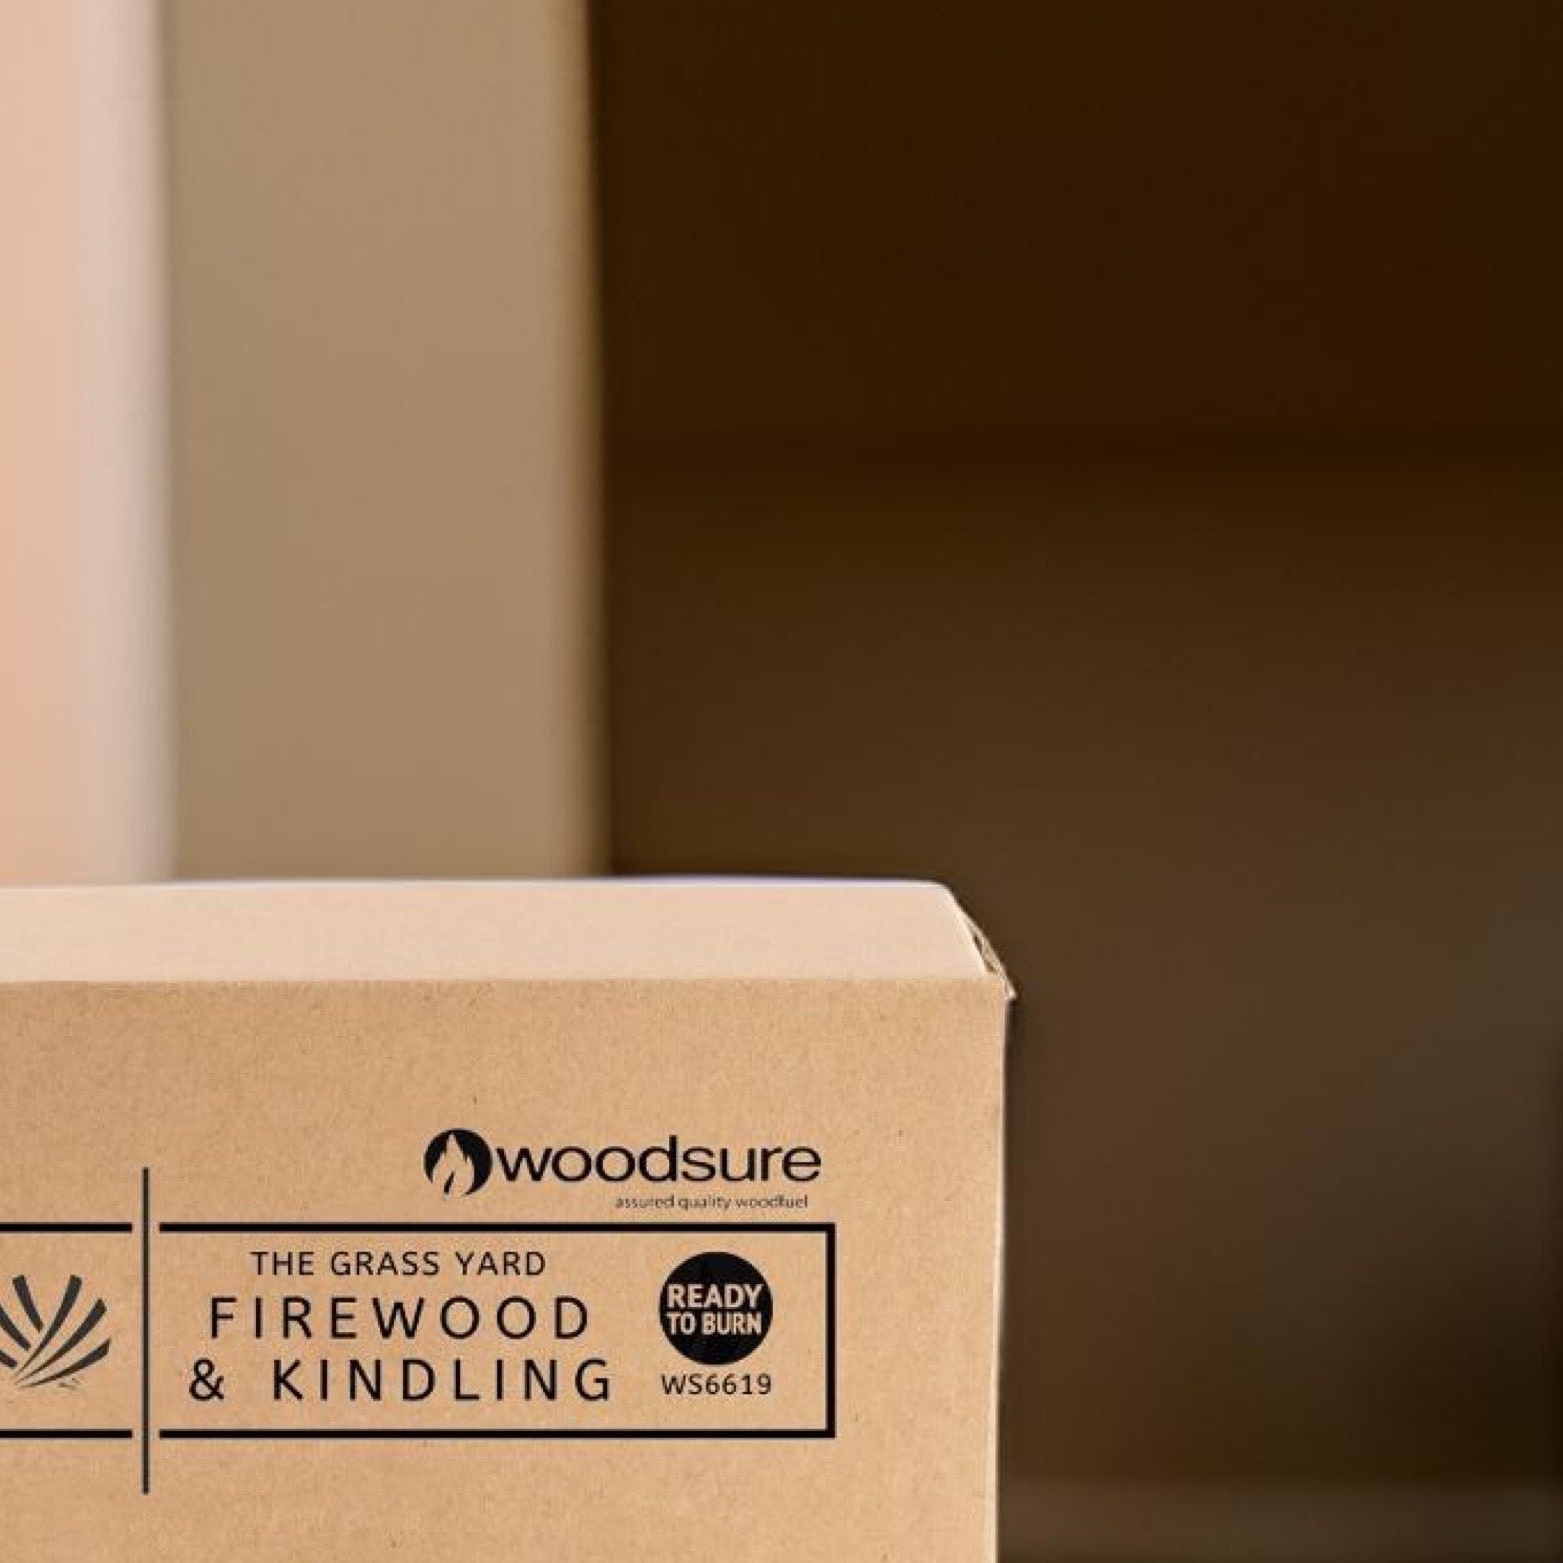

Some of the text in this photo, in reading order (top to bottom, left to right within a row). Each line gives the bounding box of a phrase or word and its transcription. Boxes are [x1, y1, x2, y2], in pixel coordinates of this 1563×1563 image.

[491, 1134, 822, 1184] woodsure
[613, 1194, 808, 1210] assured quality woodfuel
[249, 1250, 546, 1277] THE GRASS YARD
[666, 1283, 764, 1309] READY
[210, 1295, 588, 1340] FIREWOOD
[666, 1312, 763, 1336] TO BURN
[188, 1357, 610, 1402] & KINDLING
[660, 1372, 772, 1396] WS6619
